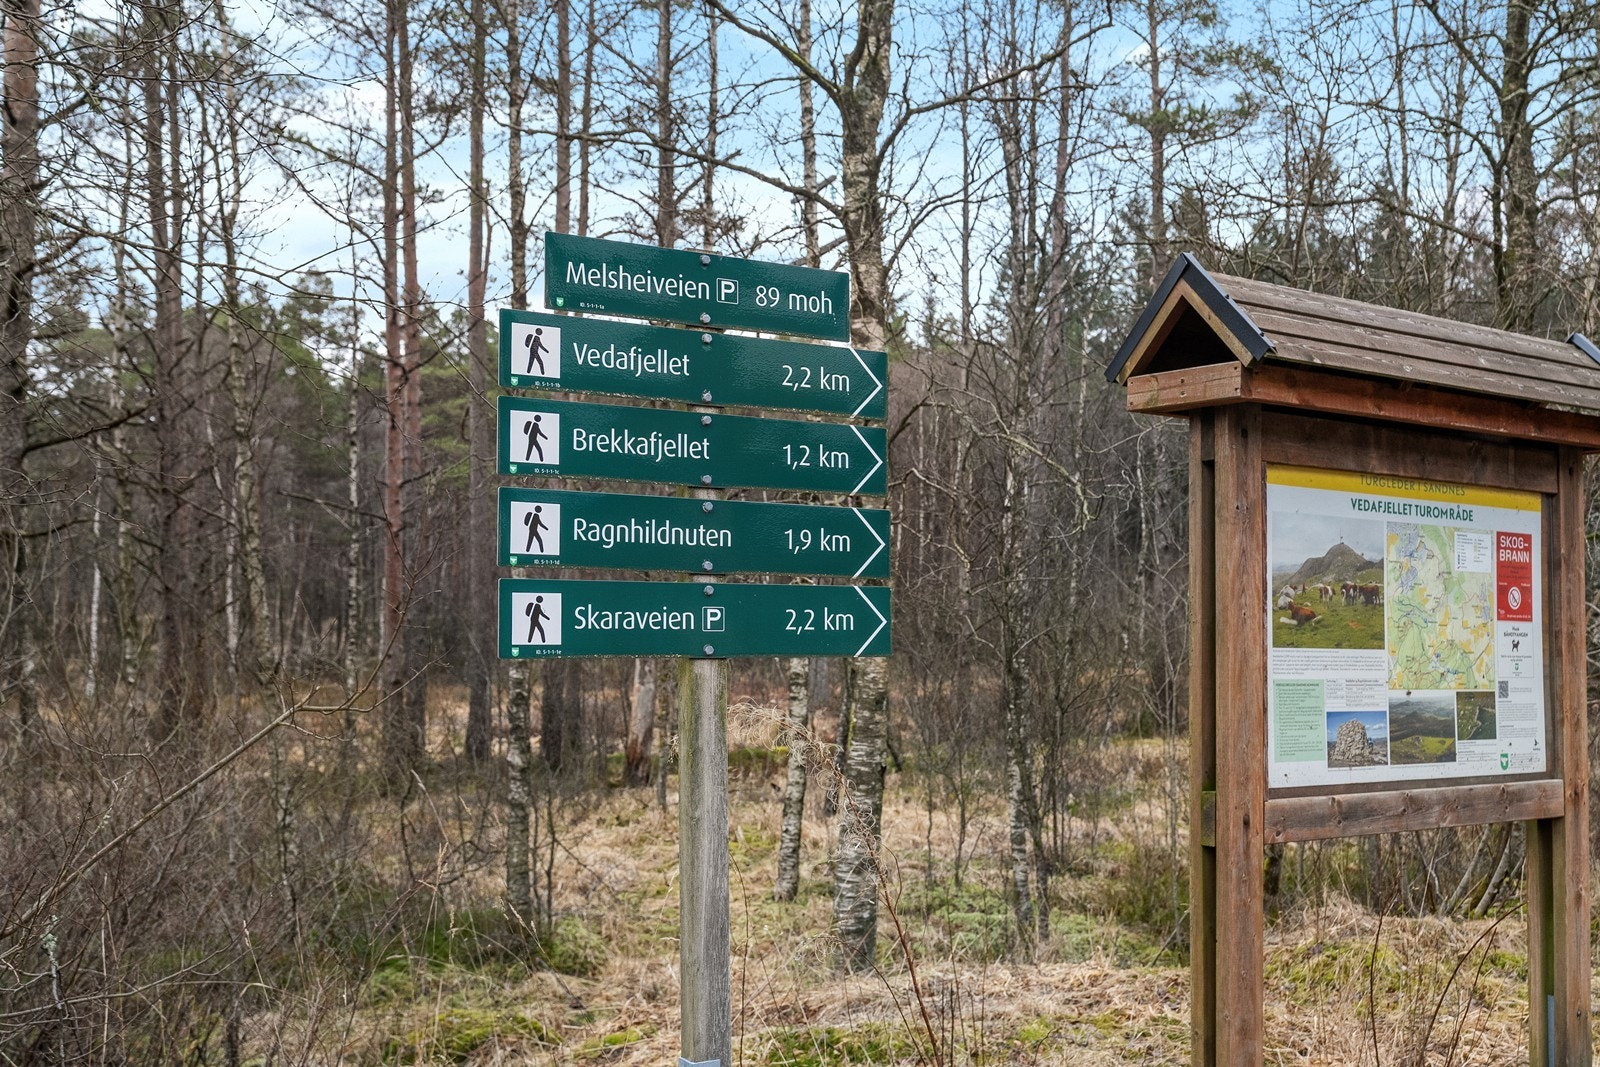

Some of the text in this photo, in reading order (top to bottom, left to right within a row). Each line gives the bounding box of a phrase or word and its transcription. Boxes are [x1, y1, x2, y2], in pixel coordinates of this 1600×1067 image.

[566, 261, 710, 300] Melsheiveien
[756, 286, 780, 307] 89
[789, 291, 833, 315] moh
[573, 342, 850, 393] Vedafjellet 2,2 km
[573, 429, 849, 471] Brekkafjellet 1,2 km
[1360, 475, 1415, 491] TURGLEDER
[1423, 481, 1466, 497] SANDNES
[1350, 498, 1474, 522] VEDAFJELLET TUROMRÅDE
[574, 518, 851, 555] Ragnhildnuten 1,9 km
[1500, 535, 1529, 549] SKOG-
[1499, 549, 1529, 563] BRANN
[574, 604, 695, 630] Skaraveien
[785, 609, 815, 635] 2,2
[824, 607, 854, 630] km
